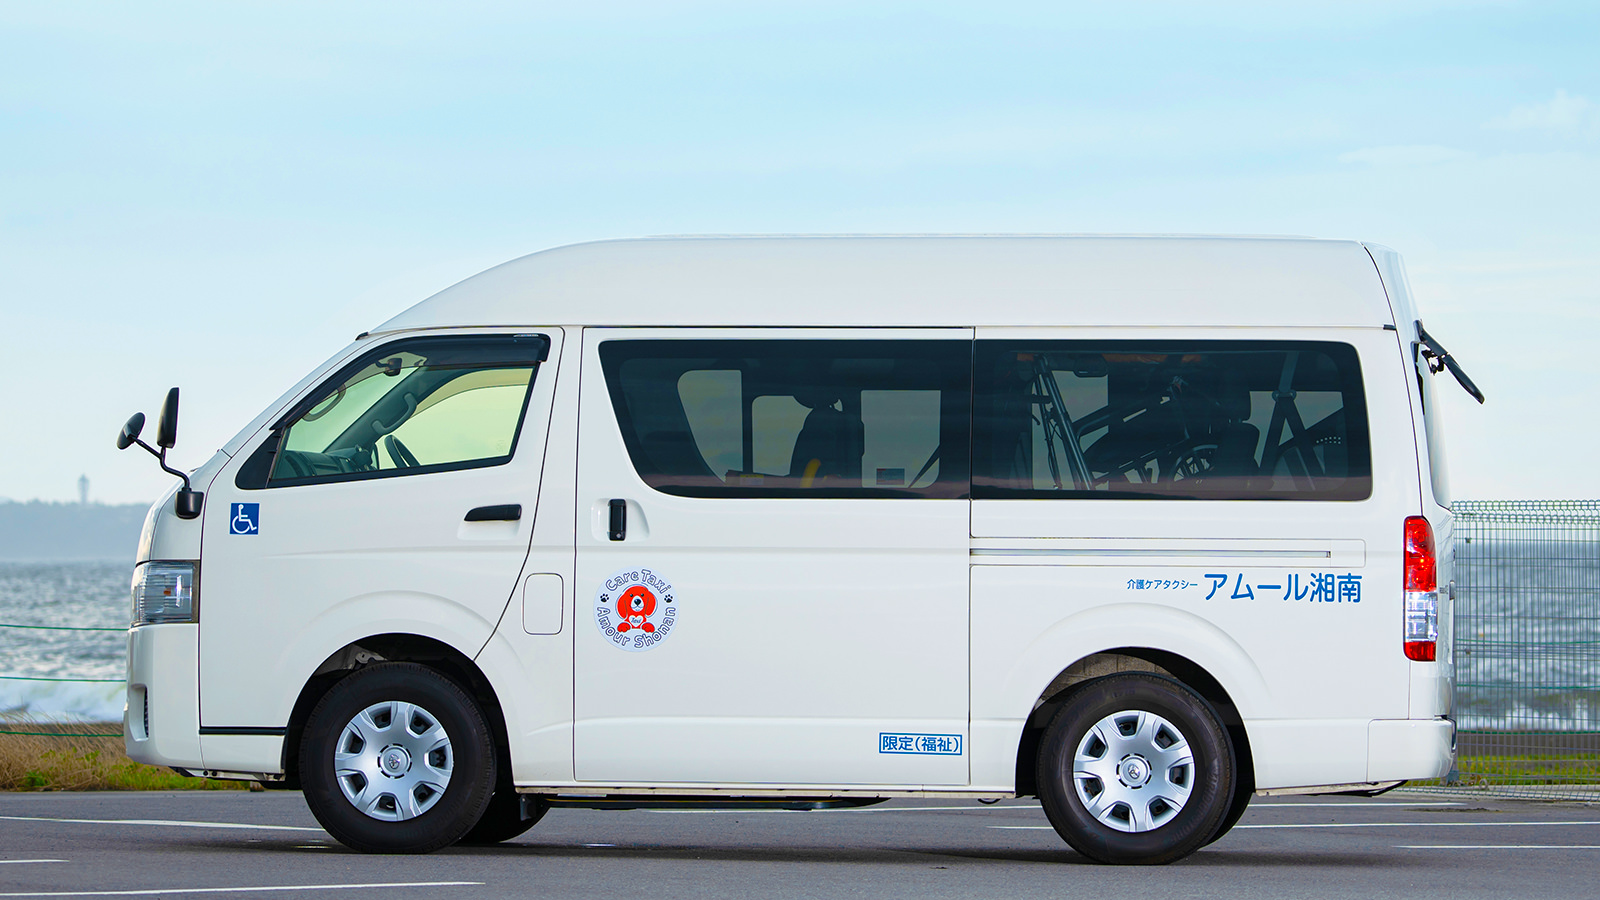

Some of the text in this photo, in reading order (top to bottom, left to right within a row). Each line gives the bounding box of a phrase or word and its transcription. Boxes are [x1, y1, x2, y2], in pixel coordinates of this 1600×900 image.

[605, 569, 671, 594] Care Taxi
[1126, 572, 1363, 603] 介護ケアタクシー アムール湘南
[597, 607, 676, 648] Amour Shonan
[882, 735, 960, 753] 限定(福祉)
